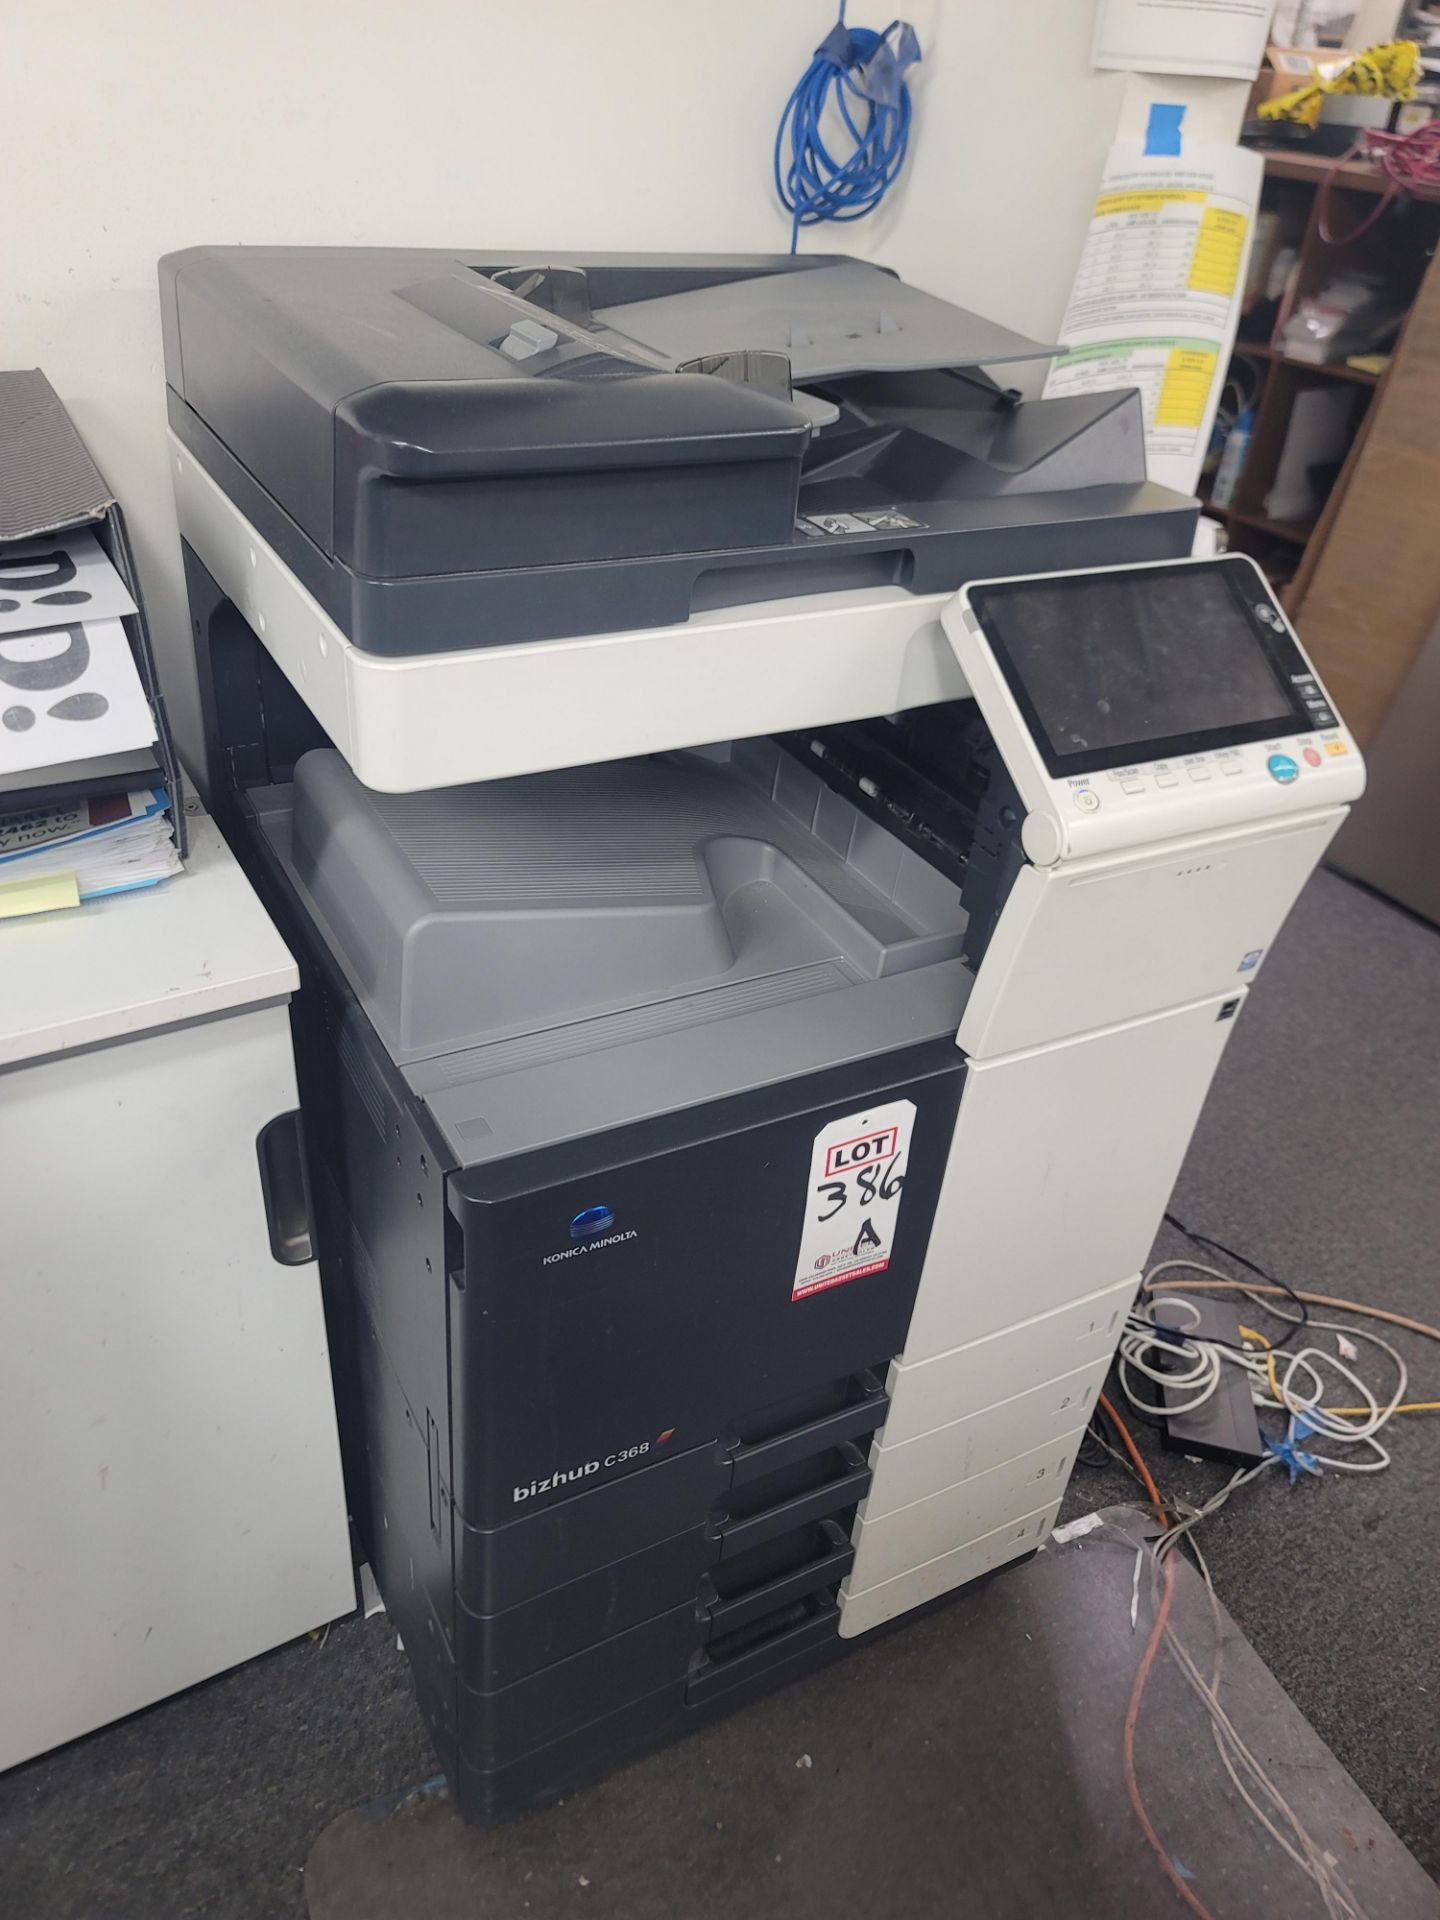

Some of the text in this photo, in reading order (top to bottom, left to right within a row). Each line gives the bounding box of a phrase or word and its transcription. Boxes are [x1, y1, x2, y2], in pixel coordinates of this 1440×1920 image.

[1067, 777, 1090, 788] Power
[56, 813, 78, 824] to
[835, 1135, 890, 1169] LOT
[817, 1151, 906, 1222] 386
[543, 1230, 638, 1266] KONICA MINOLTA
[853, 1217, 882, 1256] A
[1060, 1396, 1071, 1409] 2
[512, 1441, 650, 1502] bizhub C368
[1036, 1467, 1046, 1480] 3
